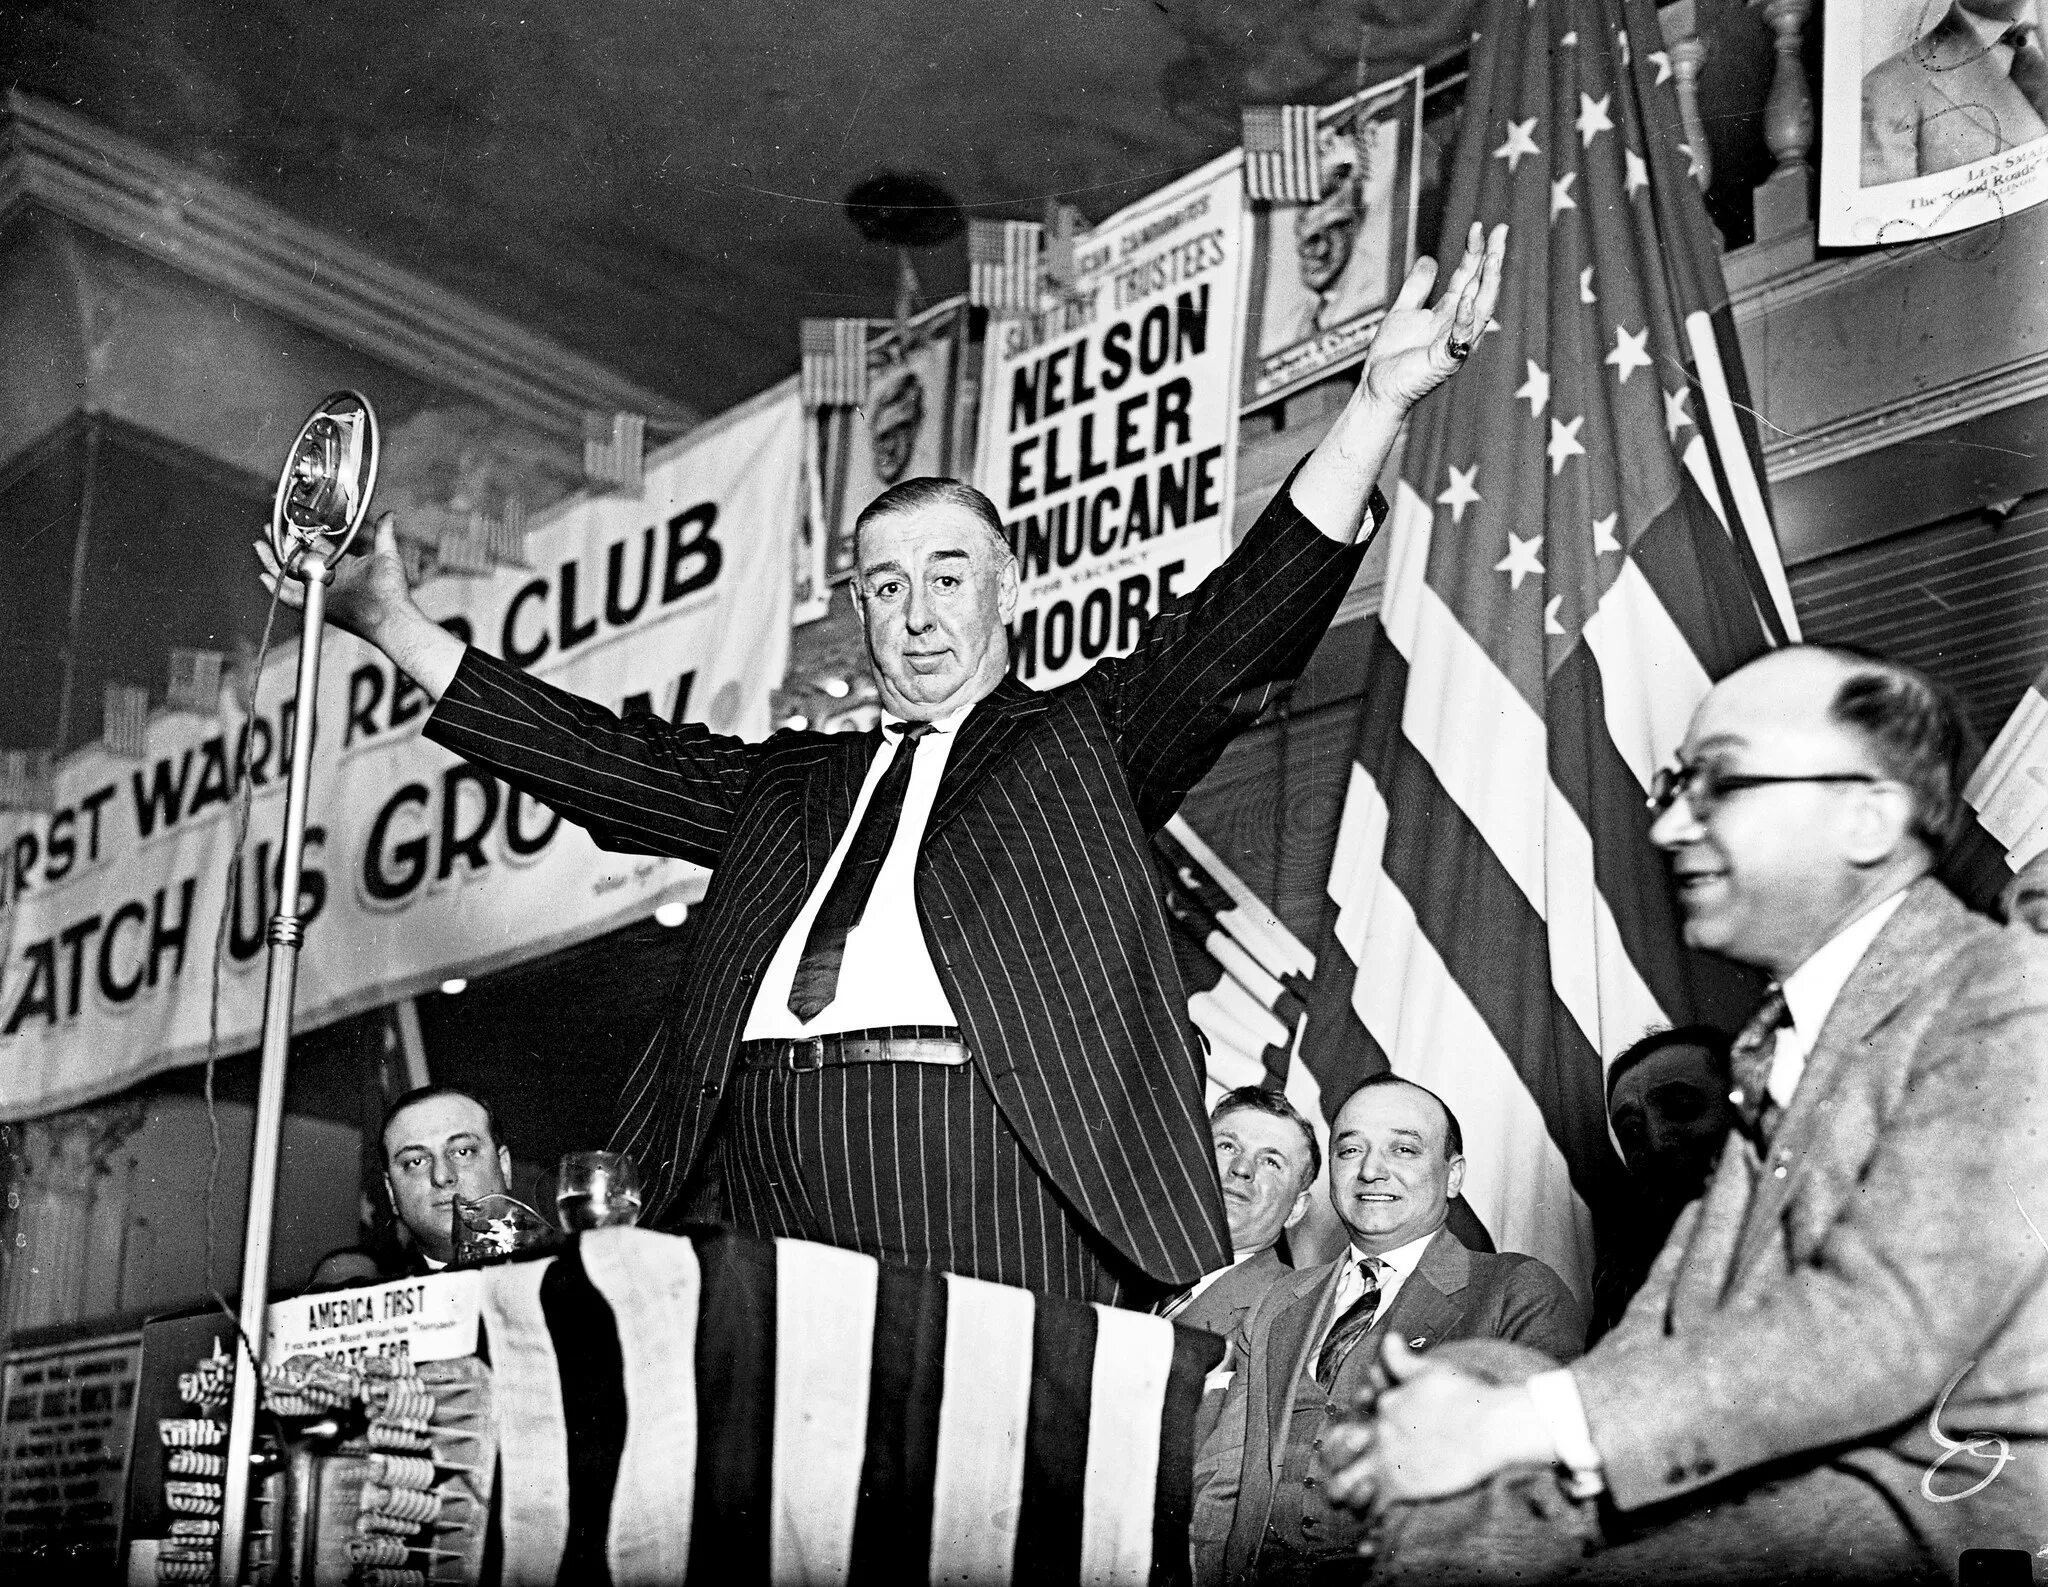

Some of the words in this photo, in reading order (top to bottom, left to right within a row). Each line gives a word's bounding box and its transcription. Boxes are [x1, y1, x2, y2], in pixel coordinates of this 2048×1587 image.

[2006, 144, 2048, 169] SMAL
[1115, 228, 1225, 311] TRUSTEES
[1009, 282, 1211, 434] NELSON
[1006, 376, 1192, 510] ELLER
[1008, 443, 1223, 582] INUCANE
[0, 783, 117, 912] RST
[500, 500, 724, 669] CLUB
[2, 876, 196, 1036] ATCH
[230, 824, 328, 961] US
[309, 1295, 374, 1332] AMERICA
[384, 1285, 426, 1320] FIRST
